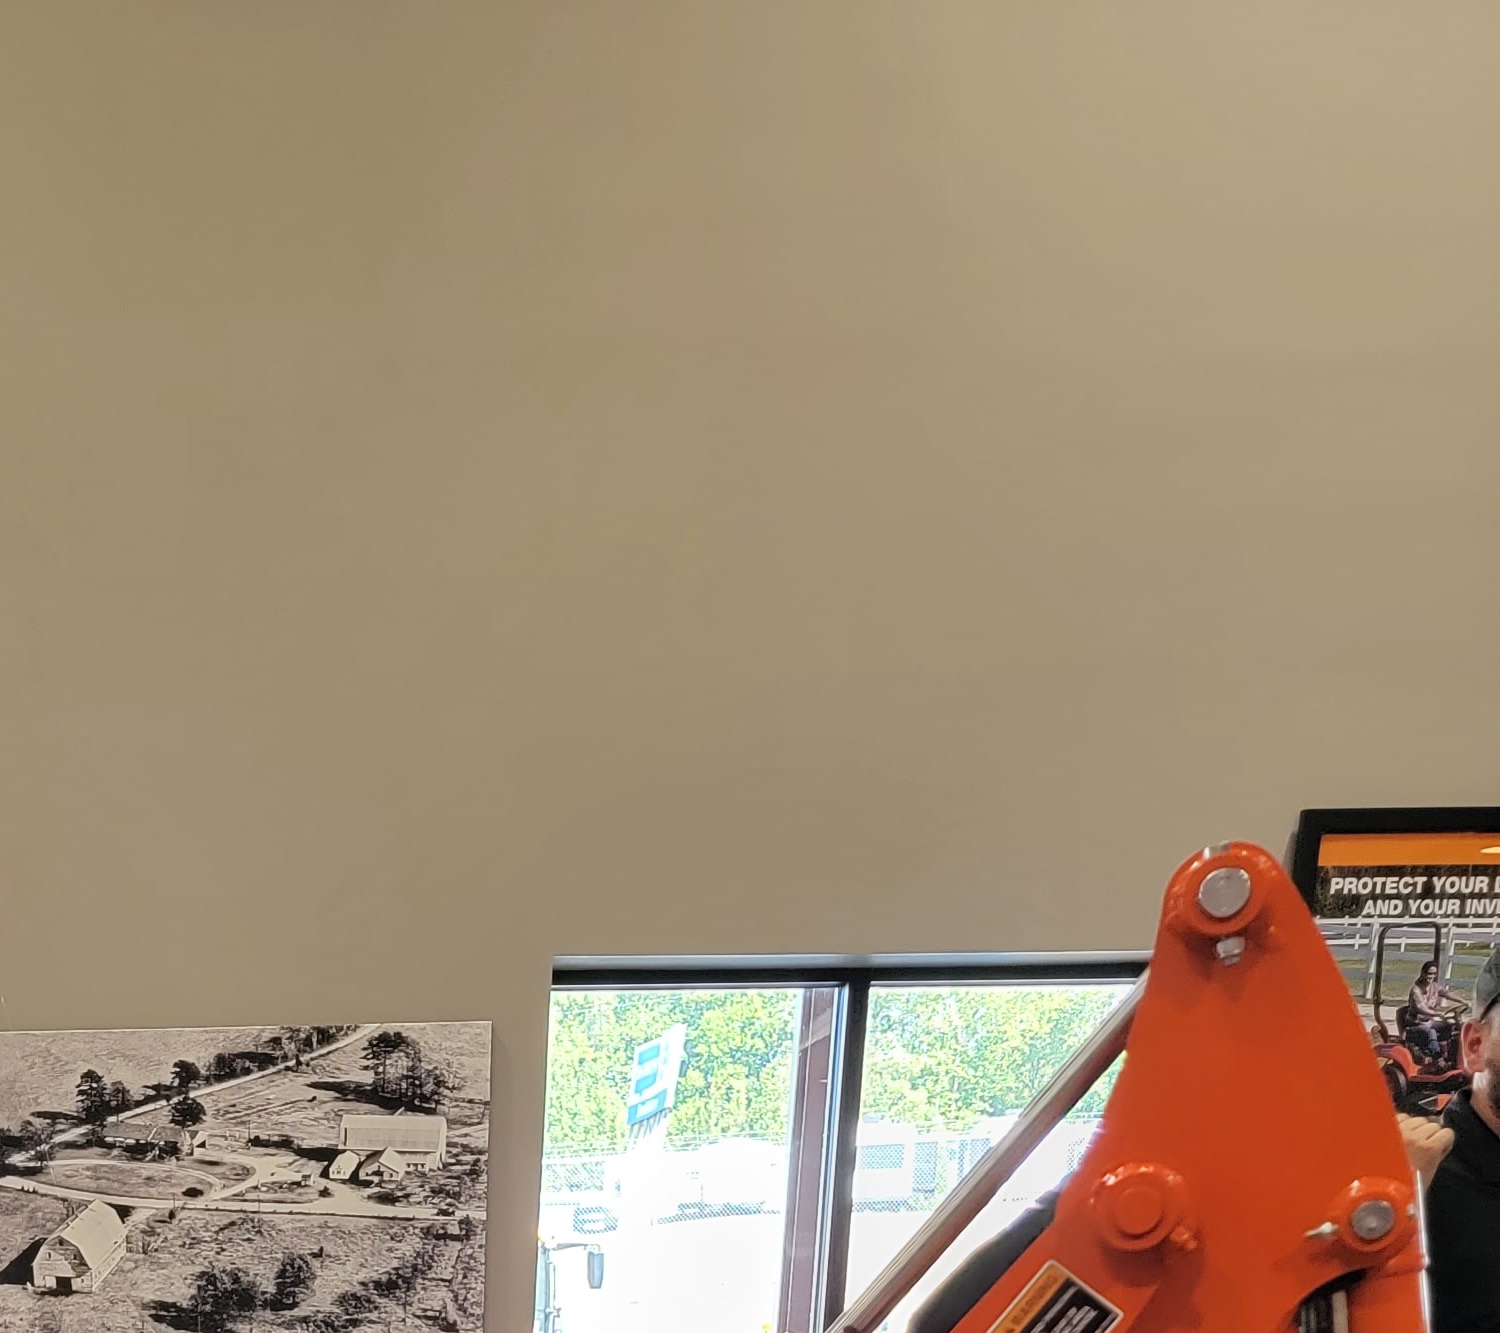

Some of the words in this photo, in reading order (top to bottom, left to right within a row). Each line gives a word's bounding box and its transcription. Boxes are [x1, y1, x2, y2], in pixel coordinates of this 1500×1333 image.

[1330, 876, 1427, 895] PROTECT
[1432, 876, 1488, 893] YOUR
[1362, 899, 1404, 915] AND
[1410, 899, 1459, 915] YOUR
